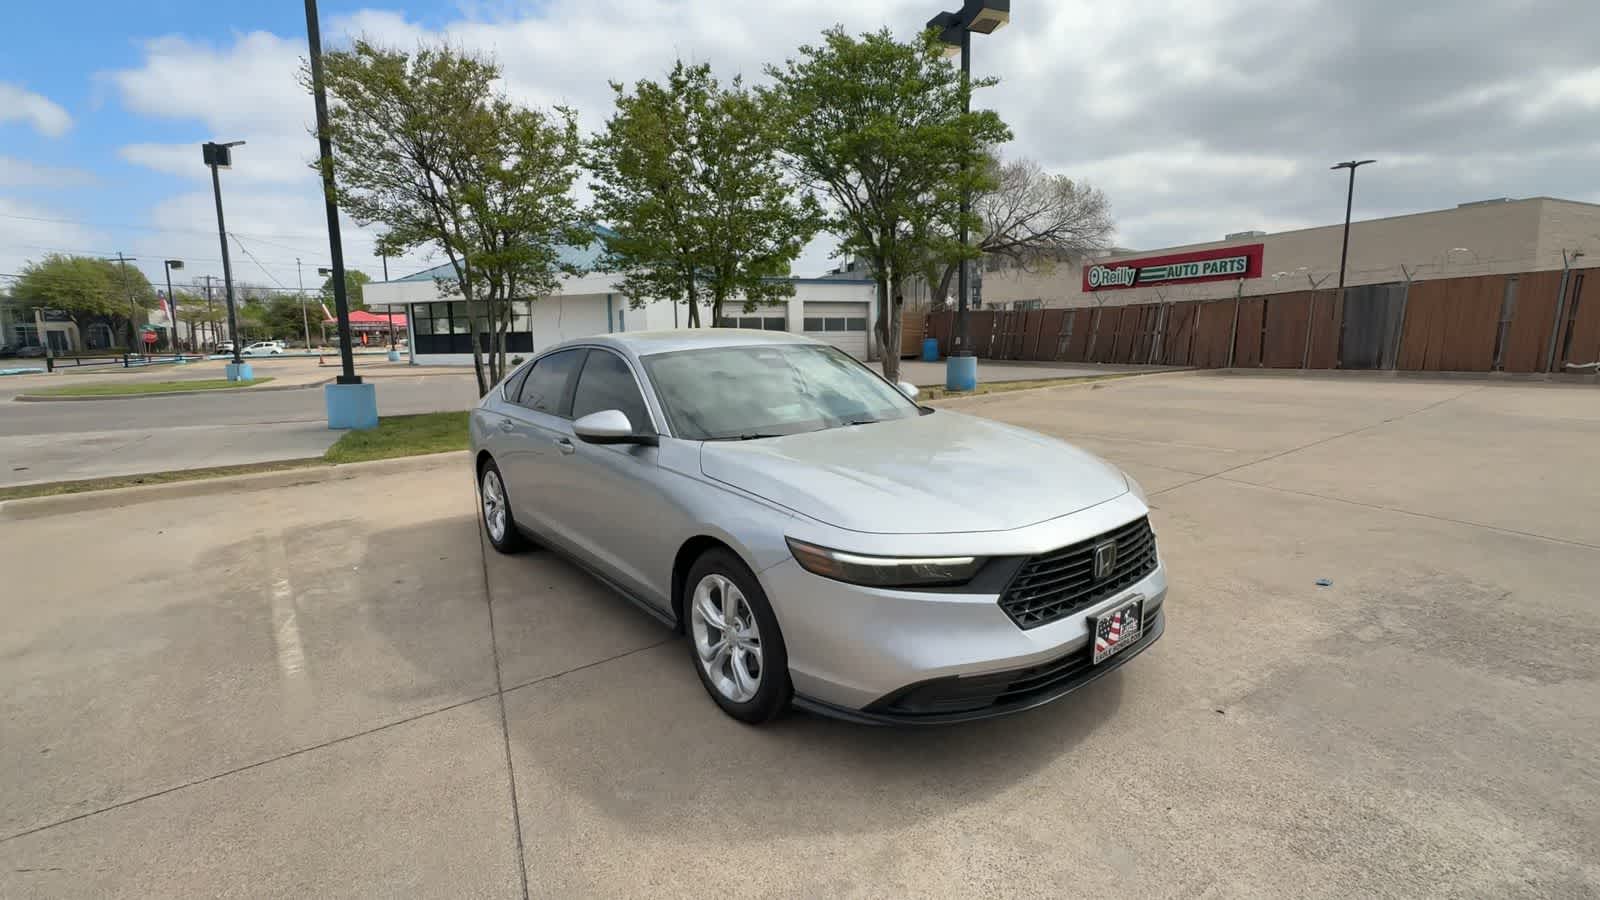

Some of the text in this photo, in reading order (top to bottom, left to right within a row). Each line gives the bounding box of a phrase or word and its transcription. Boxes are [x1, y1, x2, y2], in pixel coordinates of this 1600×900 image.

[1089, 259, 1245, 286] O'Reilly AUTO PARTS
